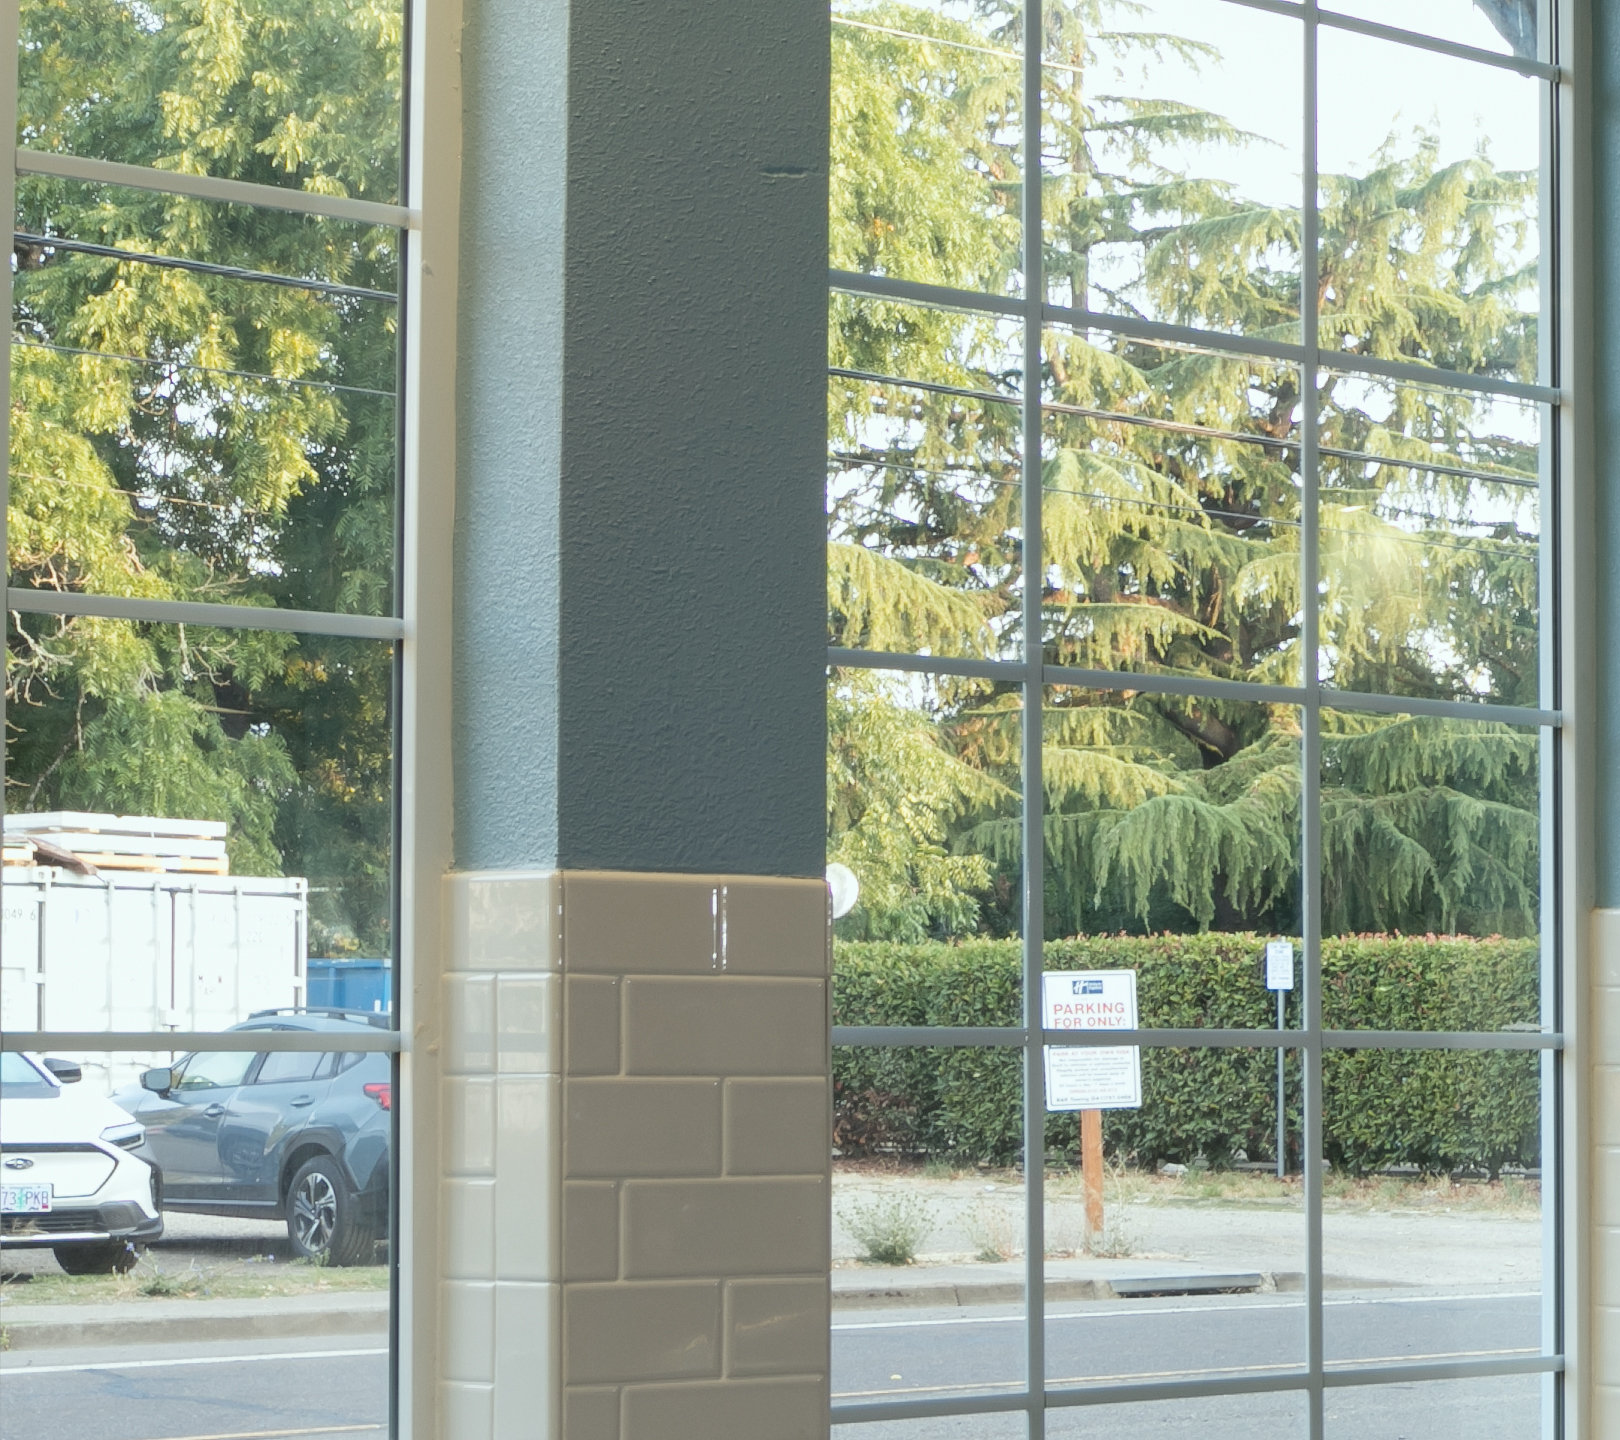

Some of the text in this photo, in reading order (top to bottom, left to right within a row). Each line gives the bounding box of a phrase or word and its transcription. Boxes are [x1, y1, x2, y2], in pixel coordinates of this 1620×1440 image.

[1053, 1002, 1125, 1015] PARKING
[1054, 1016, 1126, 1029] FOR ONLY:
